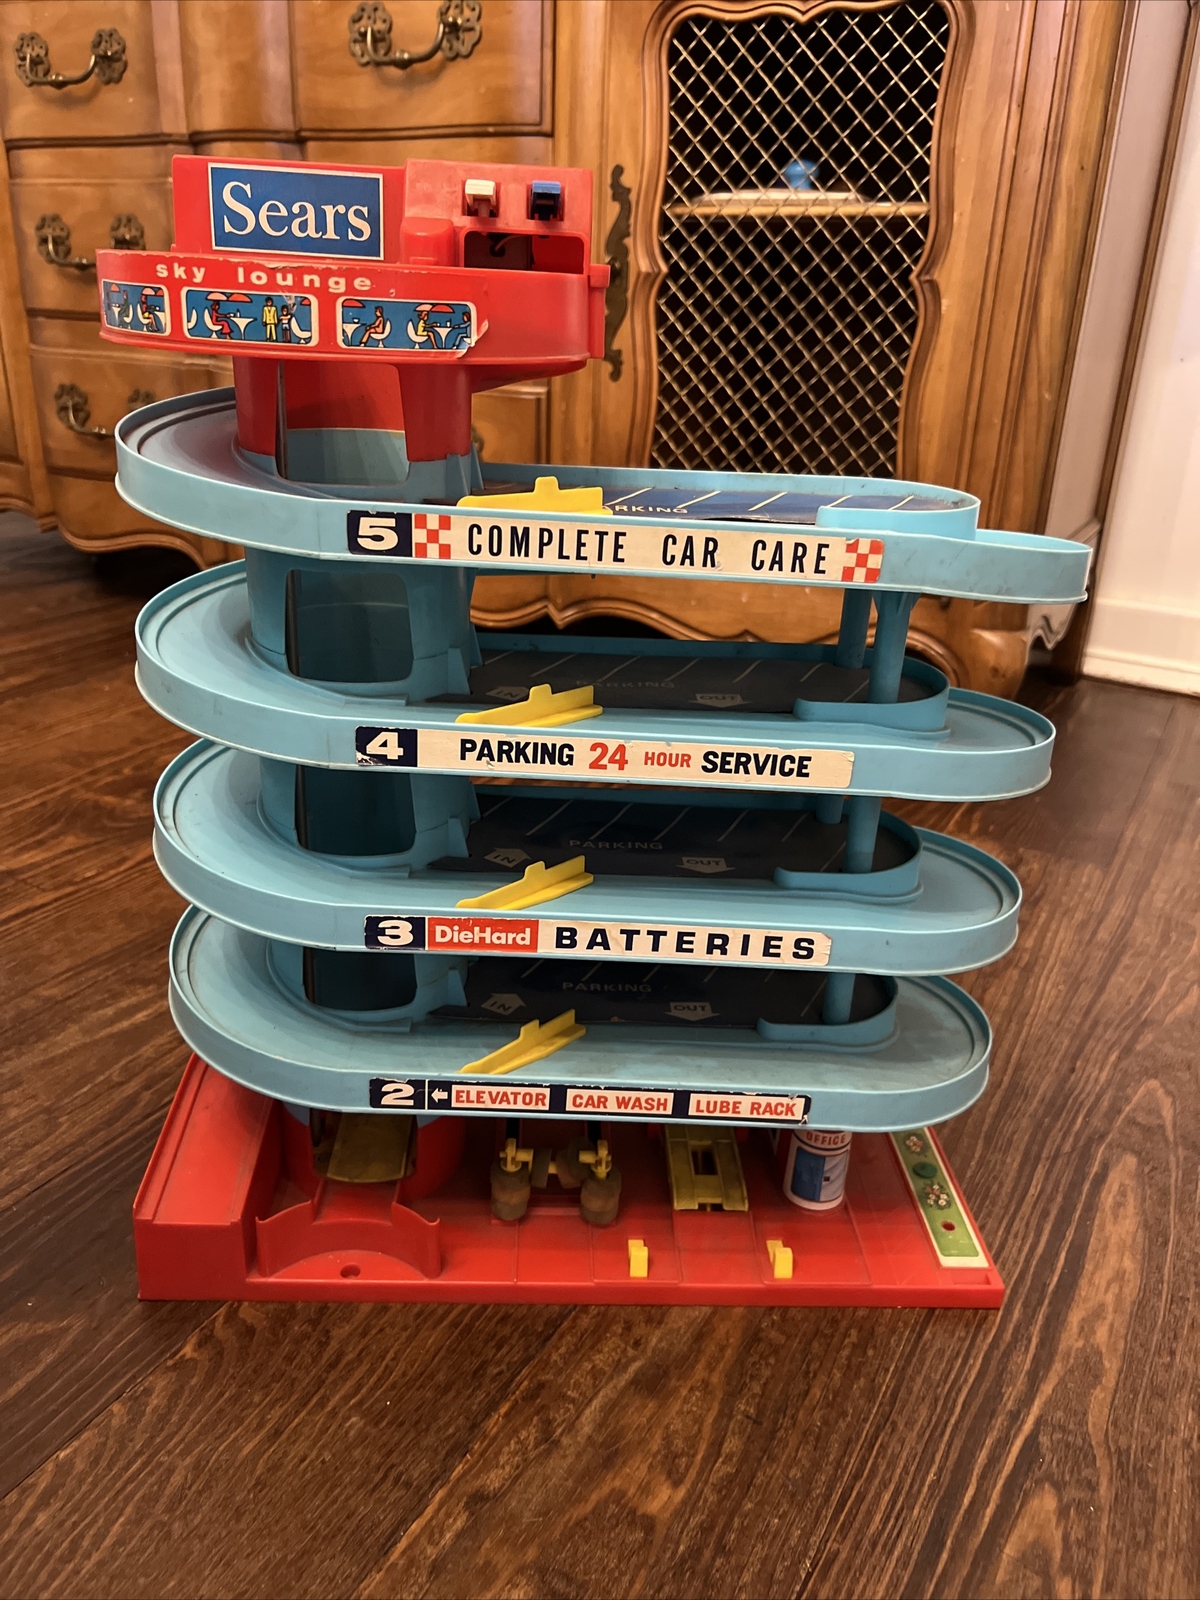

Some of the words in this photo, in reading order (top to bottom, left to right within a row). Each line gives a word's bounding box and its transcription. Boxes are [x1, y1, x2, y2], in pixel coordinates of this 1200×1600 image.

[222, 180, 371, 241] Sears
[156, 262, 206, 283] sky
[237, 267, 372, 293] lounge
[356, 518, 399, 550] 5
[468, 523, 627, 562] COMPLETE
[661, 534, 719, 568] CAR
[752, 539, 830, 574] CARE
[366, 732, 404, 760] 4
[459, 739, 575, 766] PARKING
[589, 742, 628, 771] 24
[643, 751, 691, 768] HOUR
[701, 750, 812, 778] SERVICE
[570, 839, 662, 849] PARKING
[492, 854, 516, 866] IN
[685, 858, 722, 867] OUT
[377, 920, 414, 946] 3
[435, 924, 530, 945] DieHard
[556, 926, 815, 960] BATTERIES
[562, 981, 653, 992] PARKING
[490, 1001, 512, 1012] IN
[673, 1003, 709, 1013] OUT
[380, 1083, 415, 1105] 2
[454, 1089, 547, 1107] ELEVATOR
[571, 1094, 609, 1110] CAR
[616, 1095, 669, 1112] WASH
[695, 1099, 742, 1115] LUBE
[750, 1100, 797, 1117] RACK
[806, 1131, 846, 1146] OFFICE
